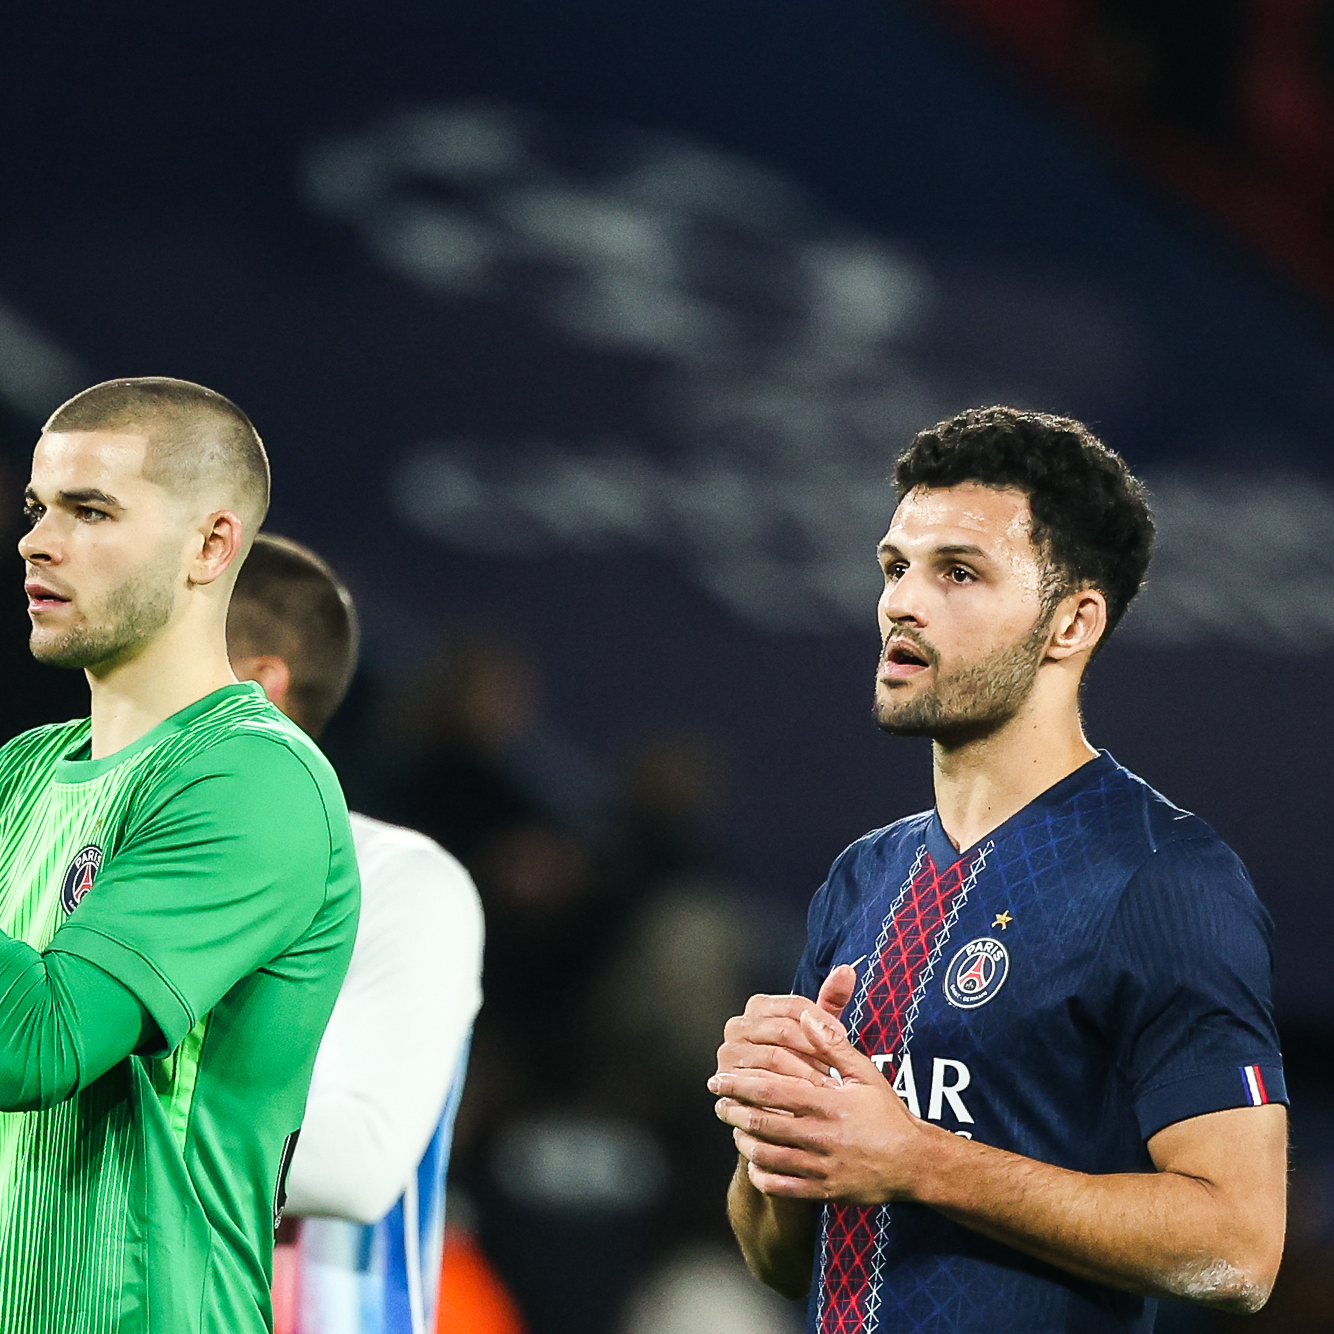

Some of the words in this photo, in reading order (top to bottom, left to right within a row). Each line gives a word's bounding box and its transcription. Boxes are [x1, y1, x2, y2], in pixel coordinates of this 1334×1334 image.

[75, 849, 102, 869] PARIS
[966, 942, 1003, 962] PARIS
[870, 1053, 975, 1124] TAR
